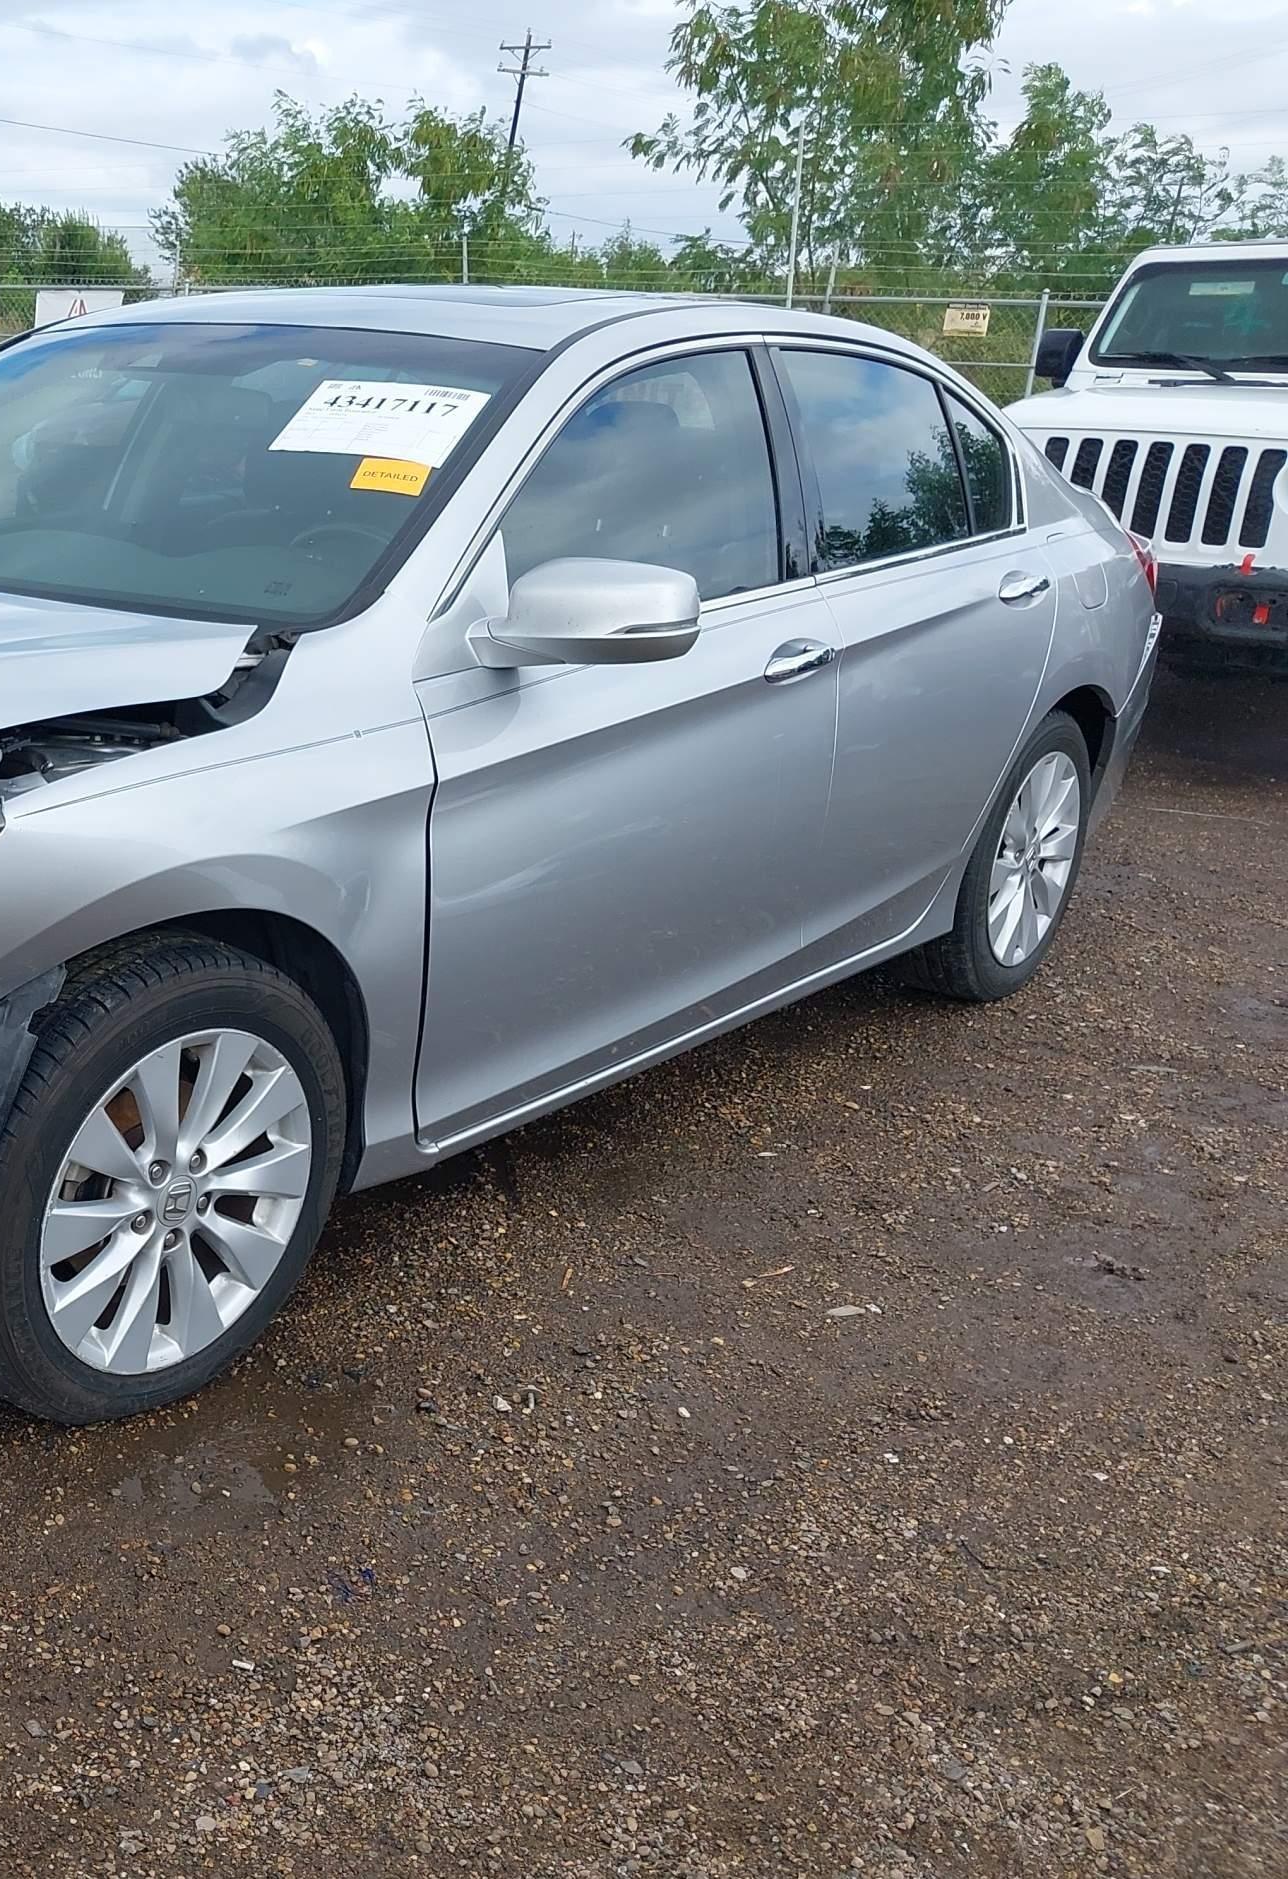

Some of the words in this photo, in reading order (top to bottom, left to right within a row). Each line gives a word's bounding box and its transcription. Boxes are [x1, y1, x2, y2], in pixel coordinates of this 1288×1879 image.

[960, 312, 980, 320] 7,000
[982, 312, 988, 320] V
[324, 395, 459, 416] 43417117
[362, 470, 418, 482] DETAILED
